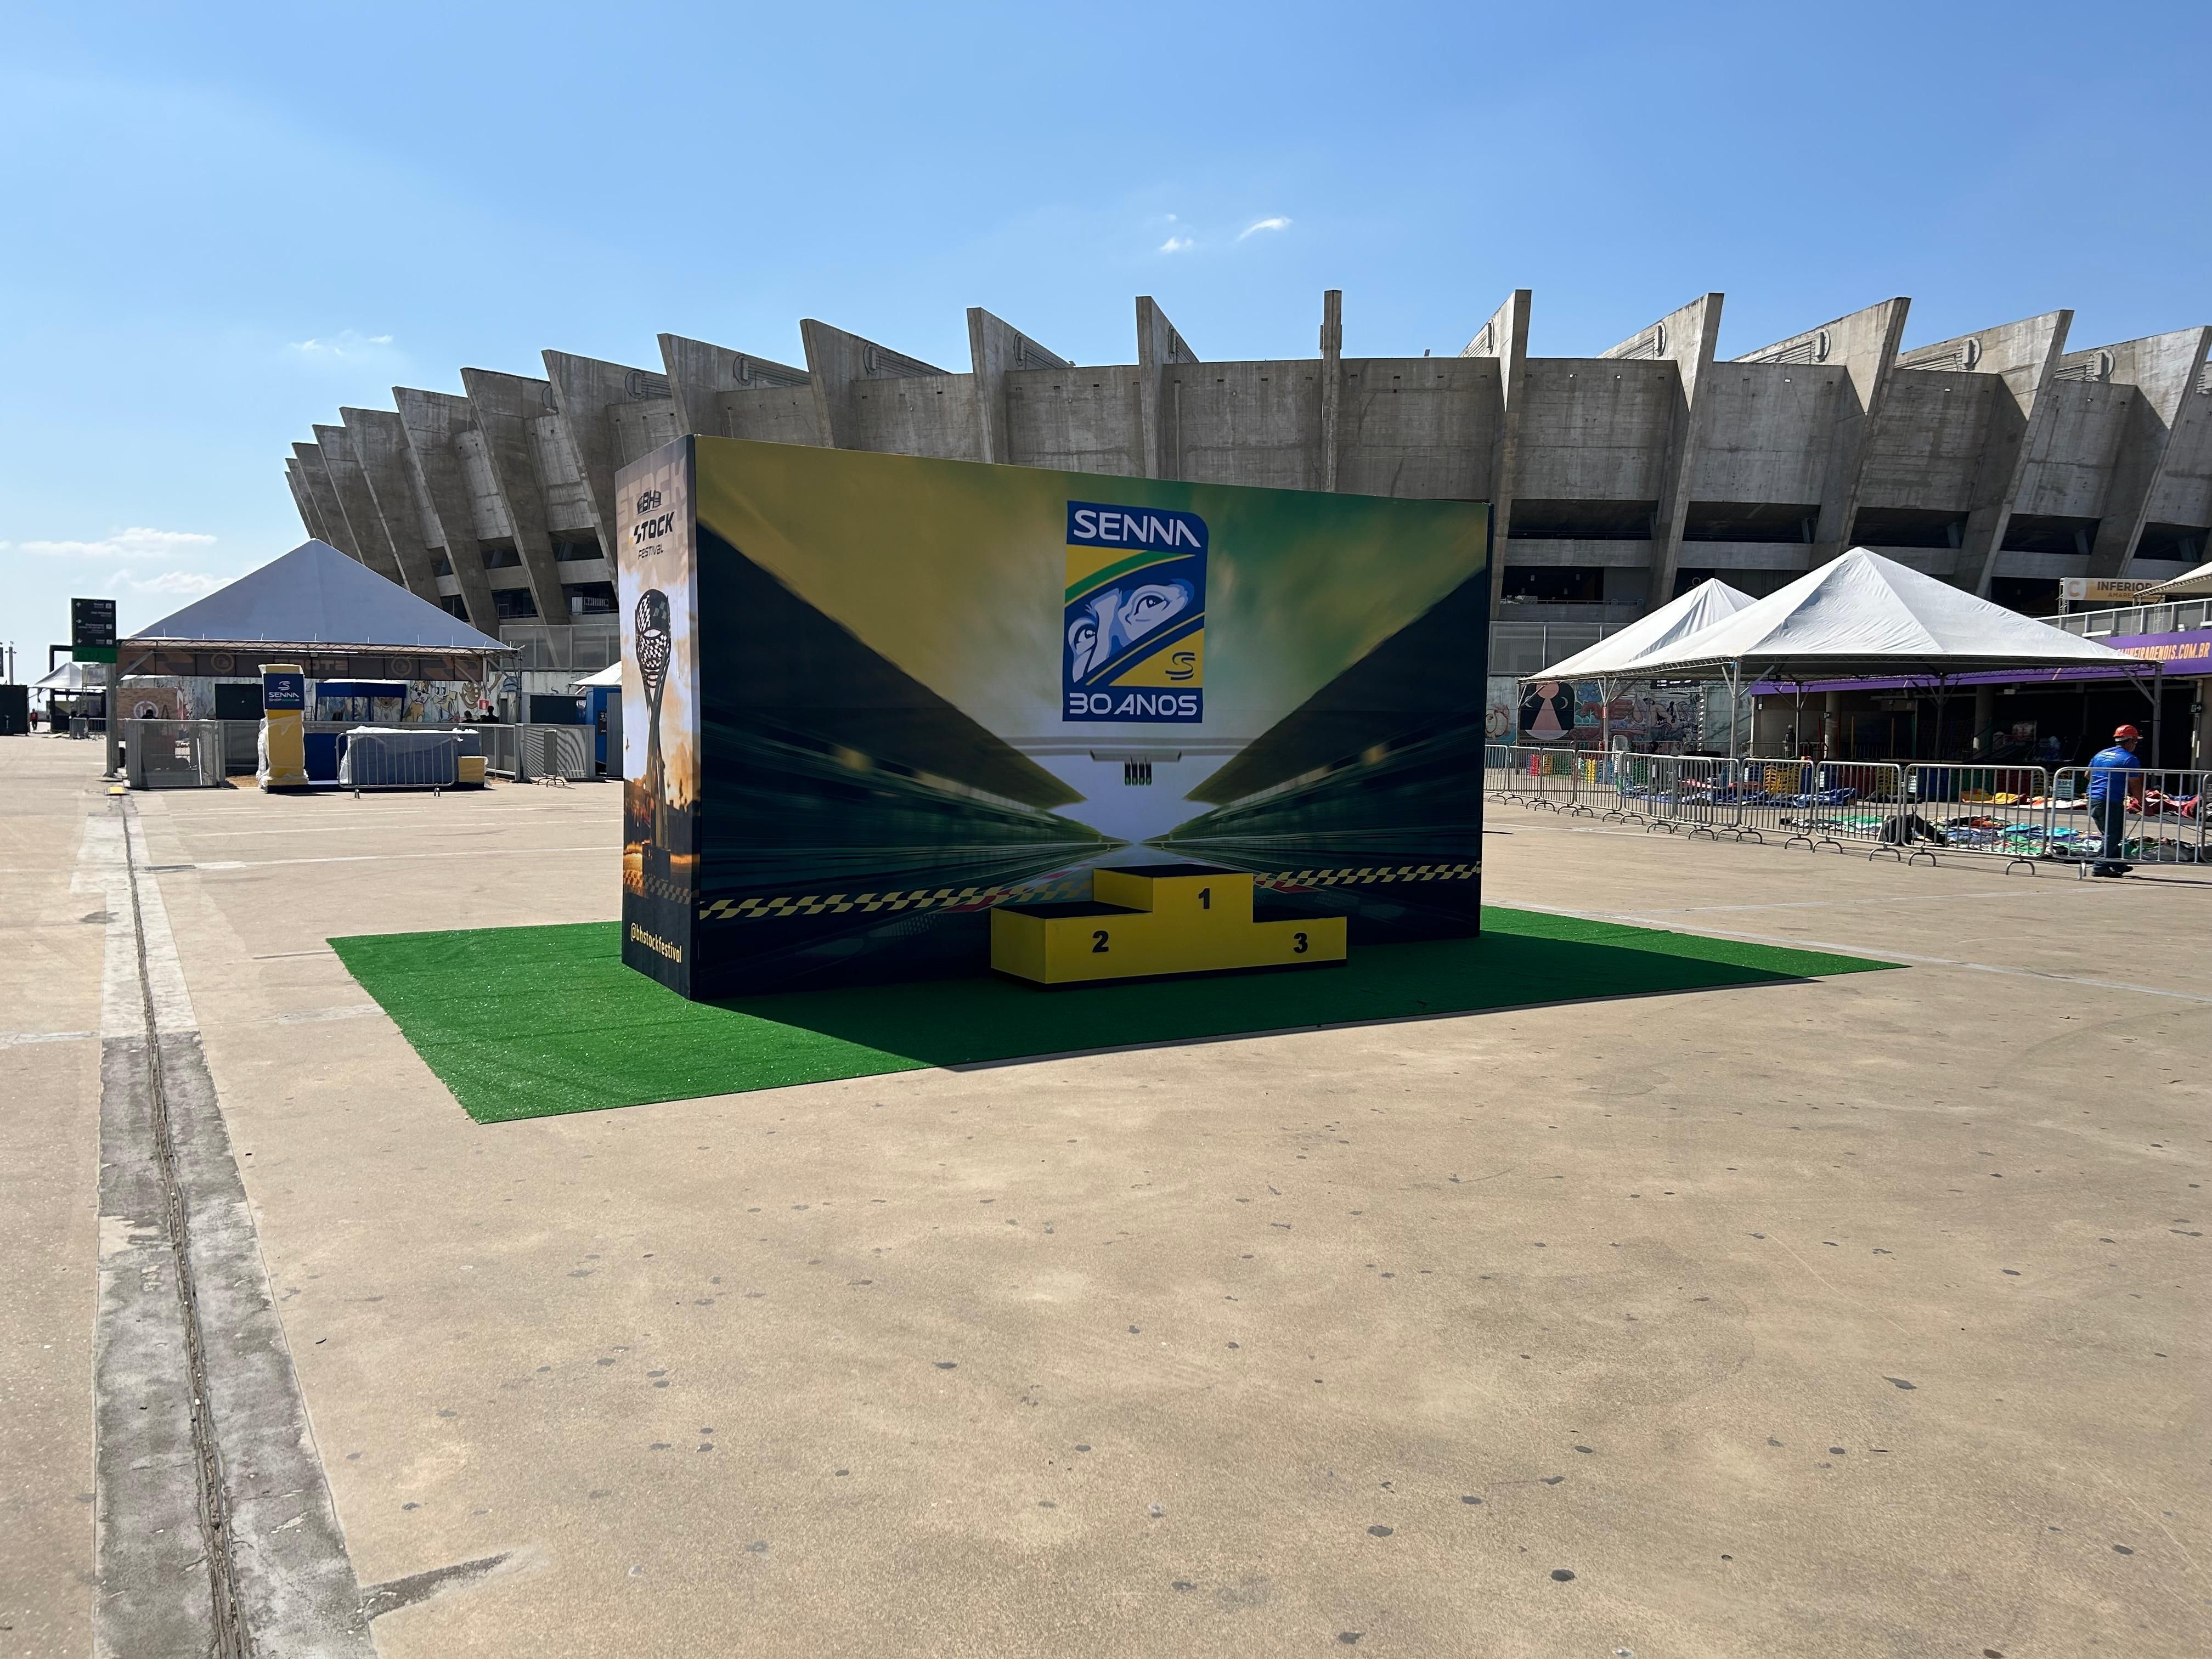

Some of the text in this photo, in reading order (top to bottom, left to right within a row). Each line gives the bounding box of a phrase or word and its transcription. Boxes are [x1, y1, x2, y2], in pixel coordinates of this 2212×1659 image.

[634, 511, 674, 544] STOCK
[1074, 510, 1201, 548] SENNA
[638, 543, 664, 560] FESTIVAL
[1070, 693, 1197, 715] 30 ANOS
[1198, 888, 1210, 909] 1
[630, 922, 682, 963] @bhstockfestival
[1092, 930, 1109, 953] 2
[1293, 932, 1308, 953] 3
